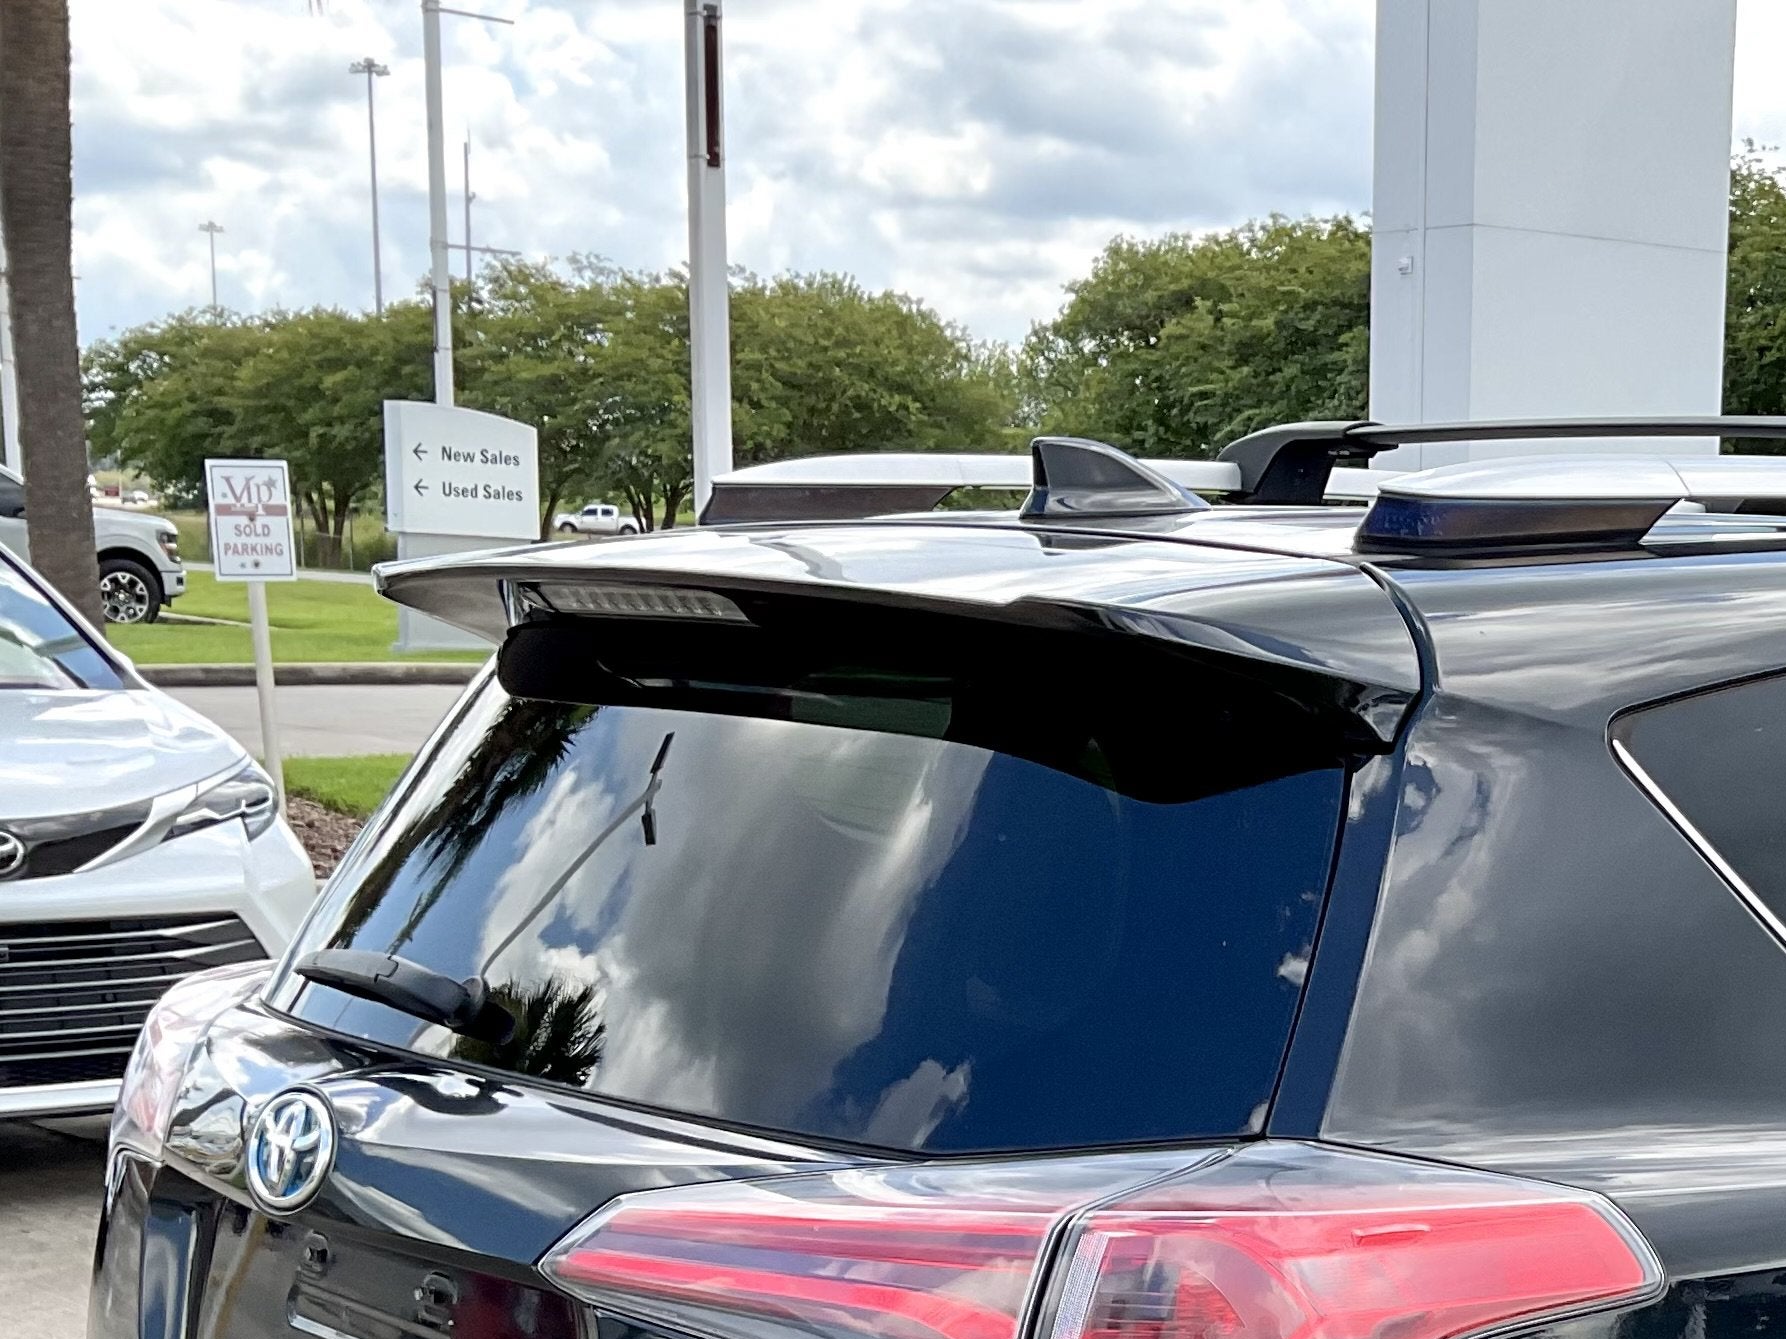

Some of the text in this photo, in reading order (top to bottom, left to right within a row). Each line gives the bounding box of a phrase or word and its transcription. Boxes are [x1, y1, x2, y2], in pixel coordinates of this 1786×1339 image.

[441, 446, 520, 466] New Sales
[442, 481, 523, 501] Used Sales
[234, 524, 271, 537] SOLD
[223, 542, 284, 557] PARKING
